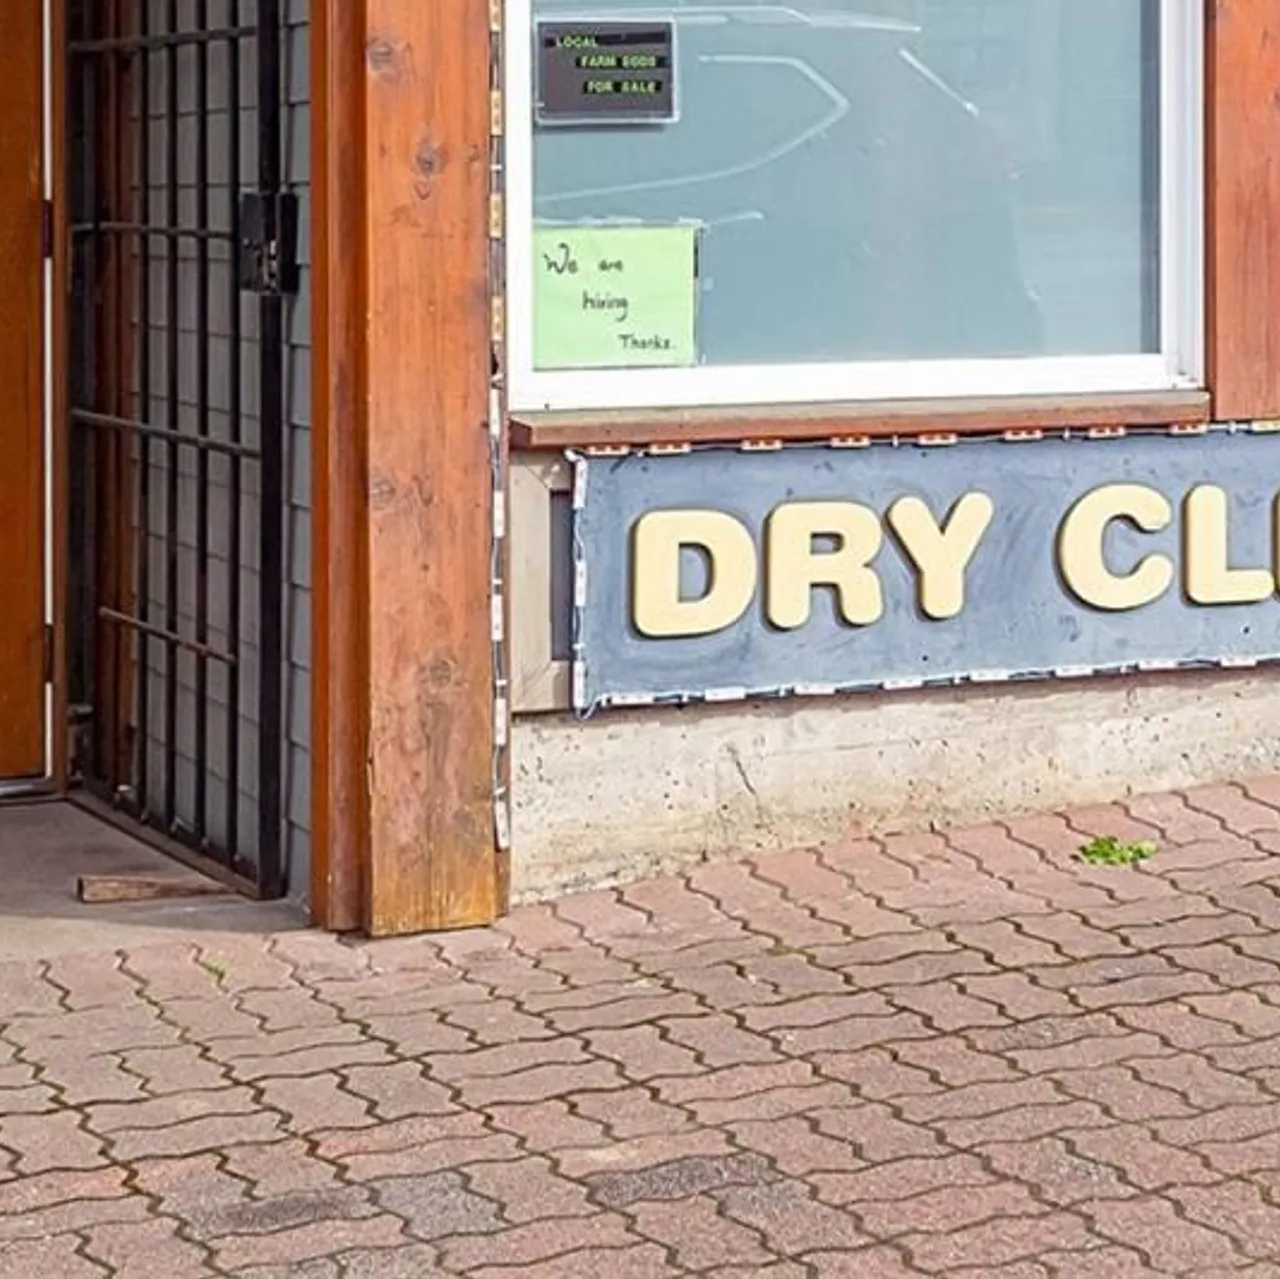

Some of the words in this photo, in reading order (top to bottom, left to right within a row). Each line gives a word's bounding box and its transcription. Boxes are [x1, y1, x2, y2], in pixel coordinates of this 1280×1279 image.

[556, 35, 599, 48] LOCAL
[581, 54, 618, 68] FARM
[587, 80, 613, 94] FOR
[621, 80, 656, 94] SALE
[543, 242, 578, 275] We
[598, 260, 623, 272] are
[582, 289, 629, 322] hiring
[631, 491, 995, 638] DRY
